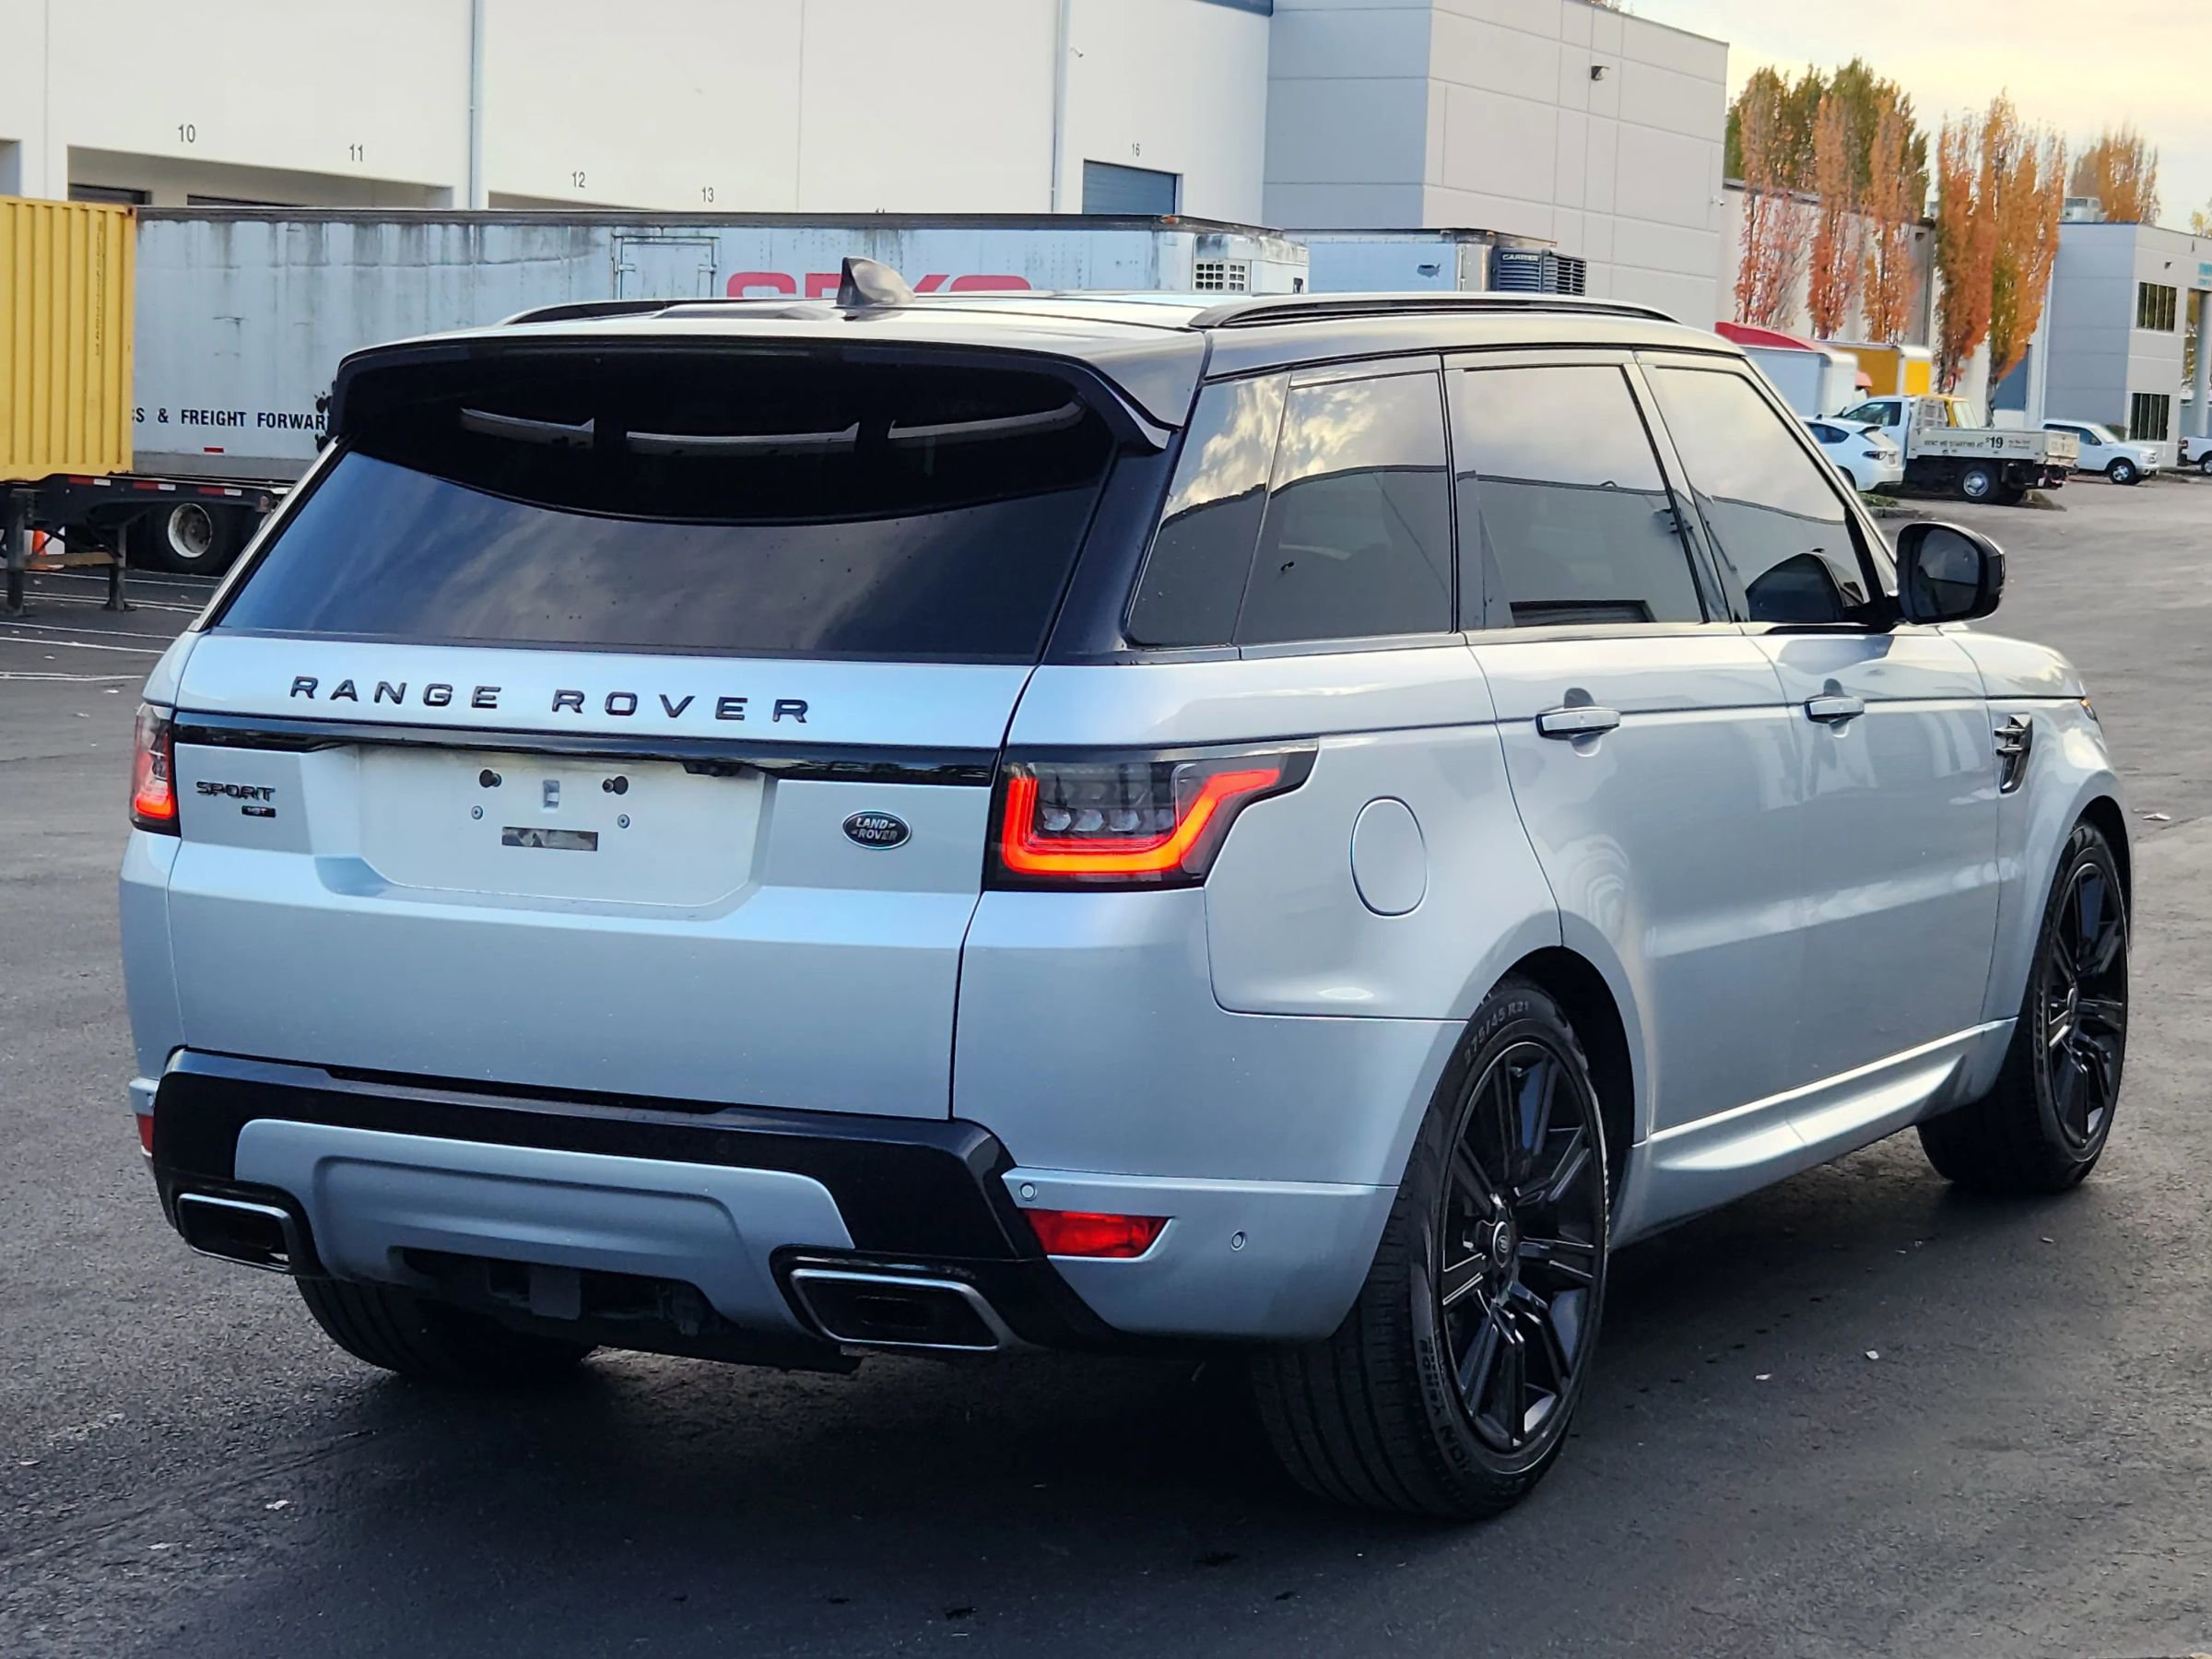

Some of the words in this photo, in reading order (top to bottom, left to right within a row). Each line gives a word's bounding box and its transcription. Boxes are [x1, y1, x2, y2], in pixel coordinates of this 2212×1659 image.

[178, 124, 195, 143] 10
[349, 144, 363, 162] 11
[1132, 144, 1140, 157] 16
[571, 171, 585, 189] 12
[701, 187, 714, 204] 13
[158, 408, 169, 423] &
[181, 409, 246, 427] FREIGHT
[1985, 437, 2004, 449] $19
[289, 676, 501, 710] RANGE
[551, 689, 811, 724] ROVER
[196, 782, 276, 802] SPORT
[855, 818, 888, 829] LAND
[858, 830, 898, 841] ROVER
